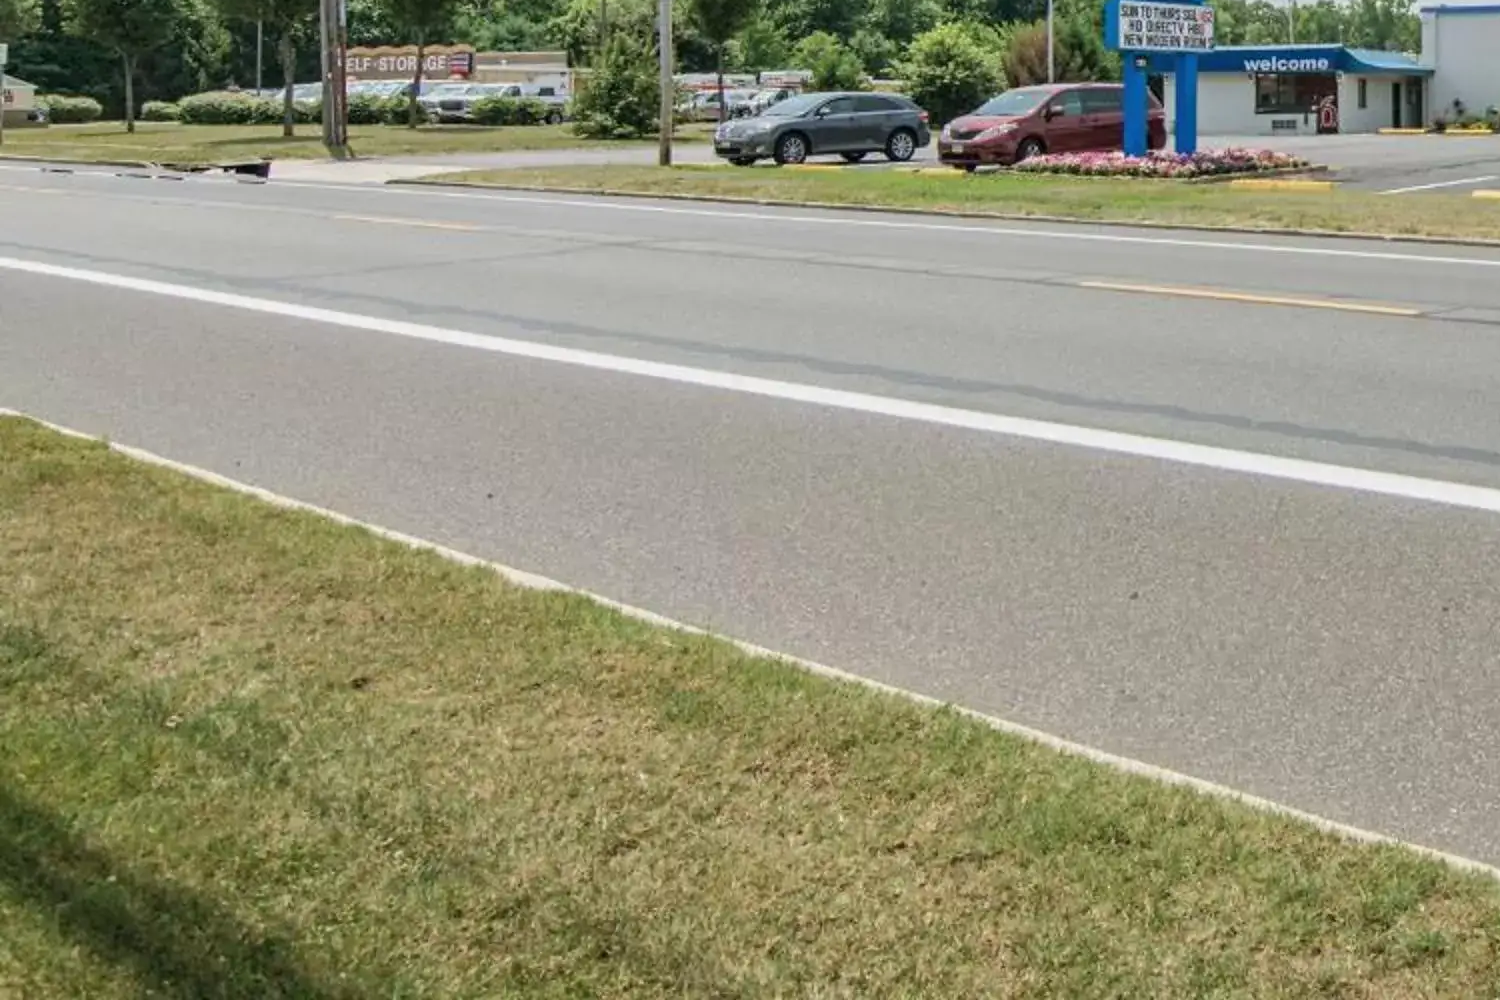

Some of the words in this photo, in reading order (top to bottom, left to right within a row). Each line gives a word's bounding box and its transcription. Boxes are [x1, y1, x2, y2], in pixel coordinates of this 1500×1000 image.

[1121, 4, 1139, 17] SUN
[1140, 6, 1152, 18] TO
[1123, 32, 1144, 46] NEW
[1146, 34, 1182, 48] MODERN
[1244, 56, 1329, 72] welcome
